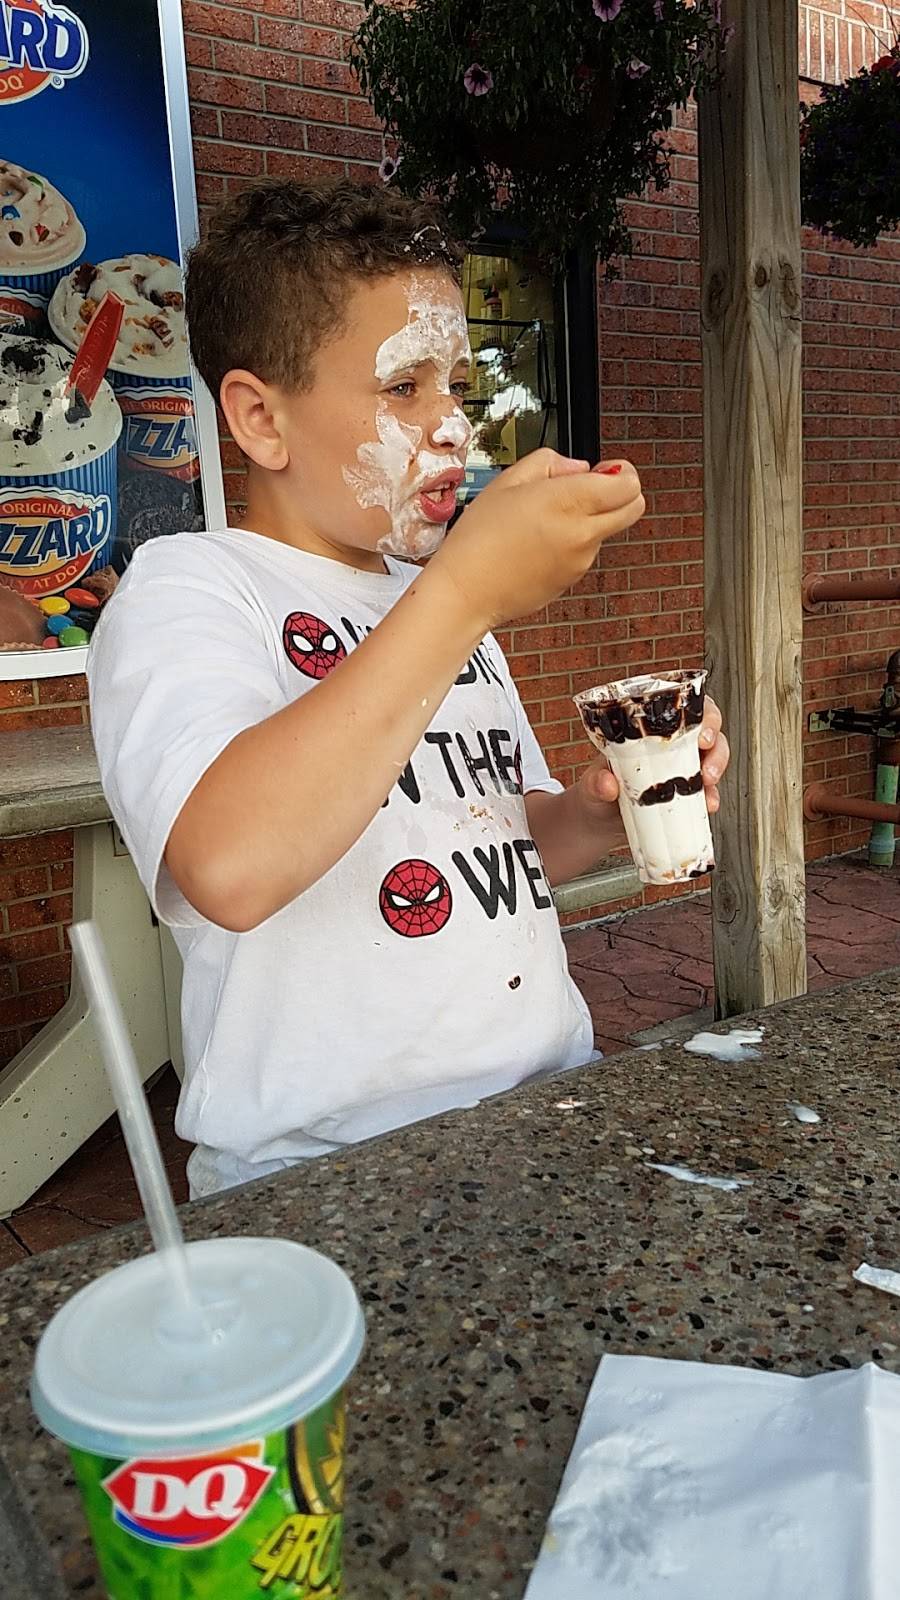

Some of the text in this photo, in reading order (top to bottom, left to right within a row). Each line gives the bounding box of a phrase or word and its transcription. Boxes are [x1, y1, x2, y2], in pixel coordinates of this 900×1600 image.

[2, 502, 75, 517] ORIGINAL
[32, 577, 51, 590] AT
[55, 564, 79, 583] DQ
[424, 729, 523, 798] THE
[452, 838, 555, 919] WE
[131, 1464, 247, 1521] DQ
